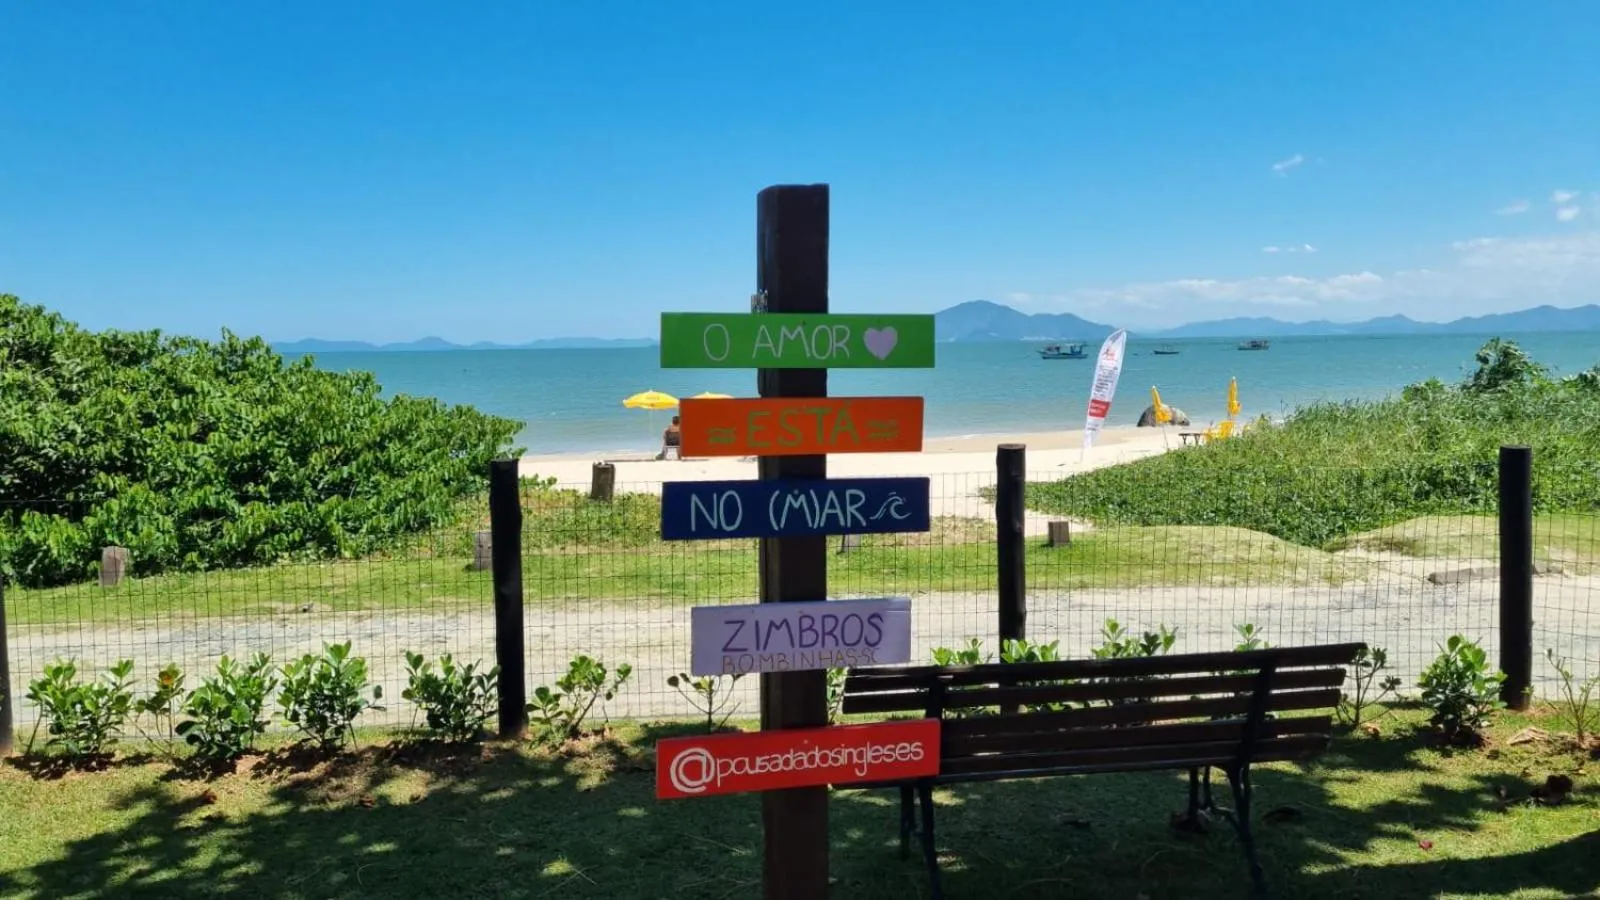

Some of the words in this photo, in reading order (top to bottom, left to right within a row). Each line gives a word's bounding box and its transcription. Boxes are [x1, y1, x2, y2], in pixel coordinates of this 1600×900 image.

[703, 323, 730, 361] O
[752, 324, 850, 360] AMOR
[746, 402, 858, 448] ESTÁ
[691, 490, 743, 532] NO
[769, 489, 867, 530] (M)AR
[722, 612, 884, 652] ZIMBROS
[670, 741, 925, 793] @pousadadosingleses
